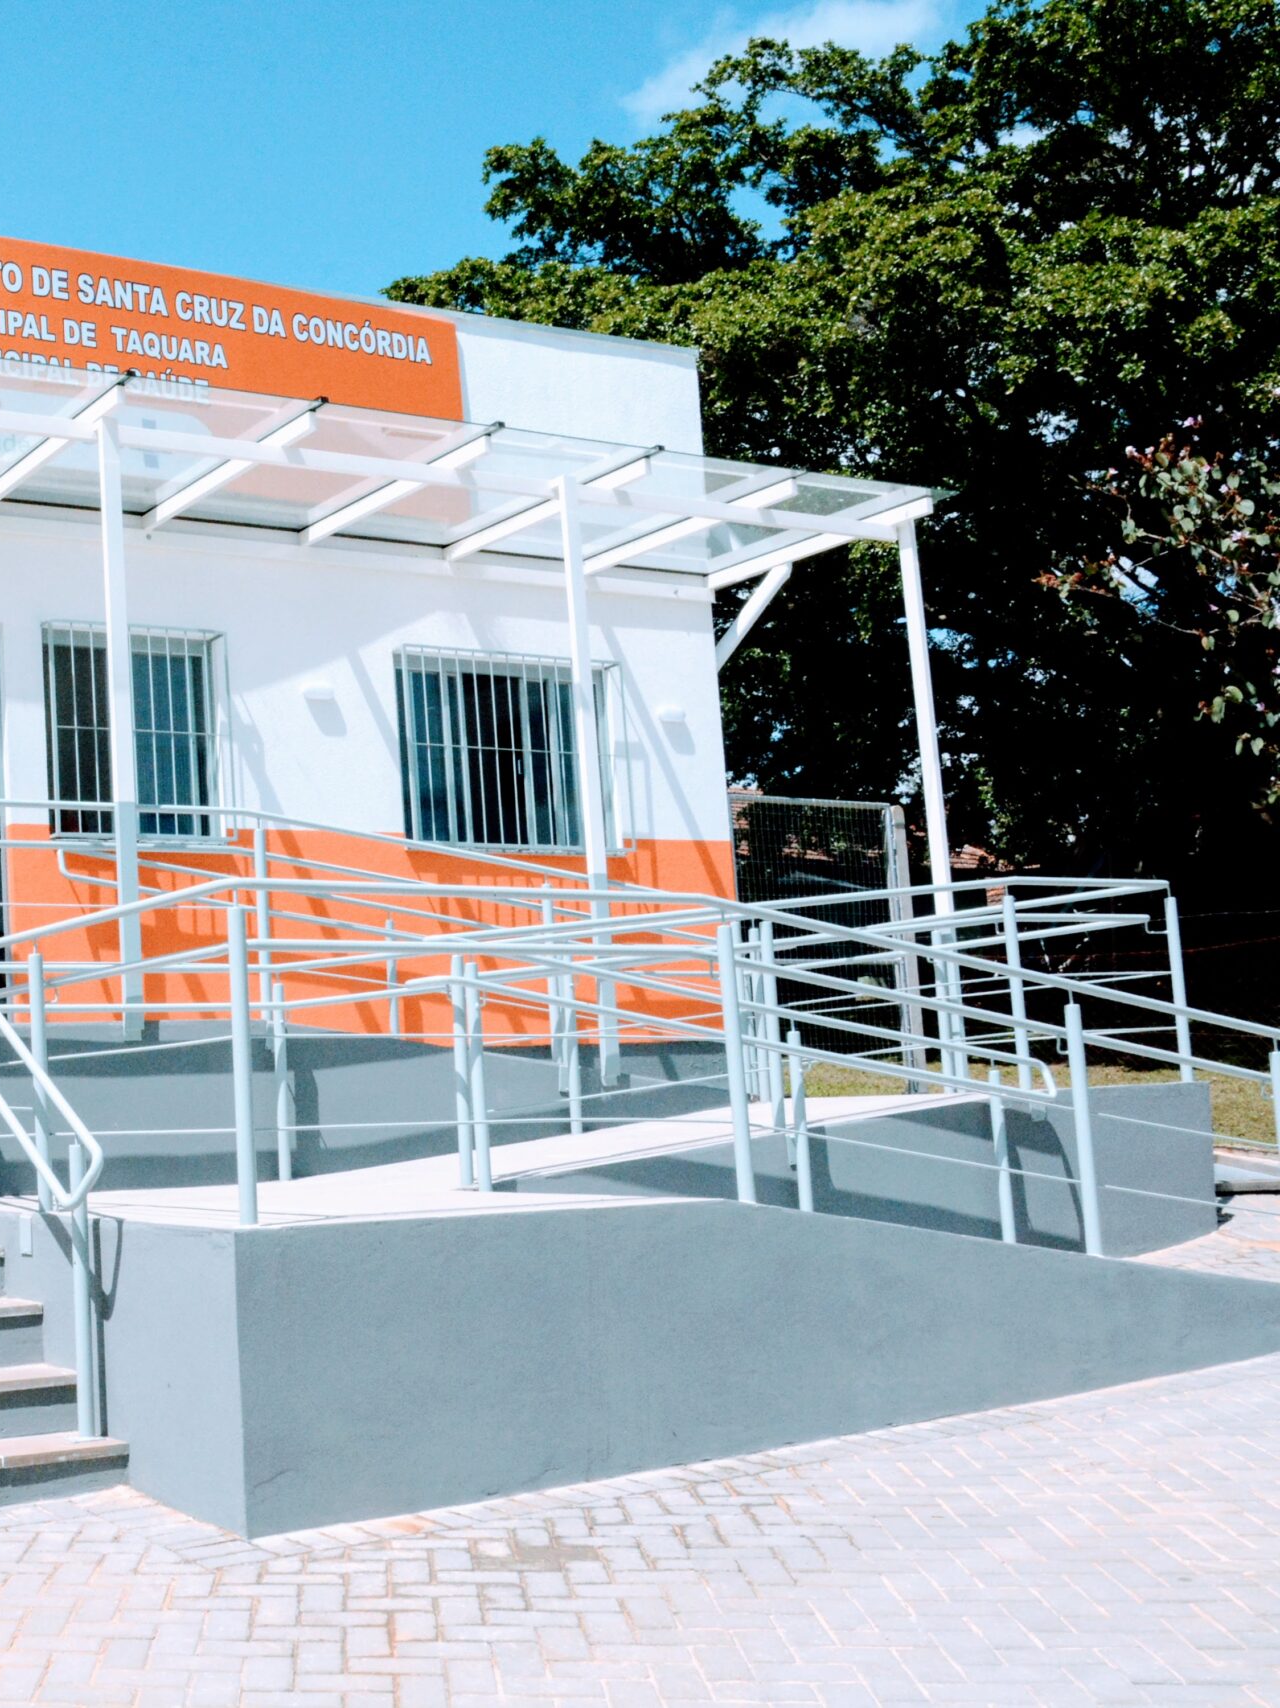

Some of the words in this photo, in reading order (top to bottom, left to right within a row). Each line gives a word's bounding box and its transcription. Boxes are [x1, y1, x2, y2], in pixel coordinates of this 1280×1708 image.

[31, 265, 69, 301] DE
[77, 272, 169, 318] SANTA
[175, 291, 246, 331] CRUZ
[252, 304, 287, 338] DA
[291, 312, 433, 366] CONCÓRDIA
[63, 319, 97, 348] DE
[110, 325, 228, 370] TAQUARA
[86, 361, 120, 390] DE
